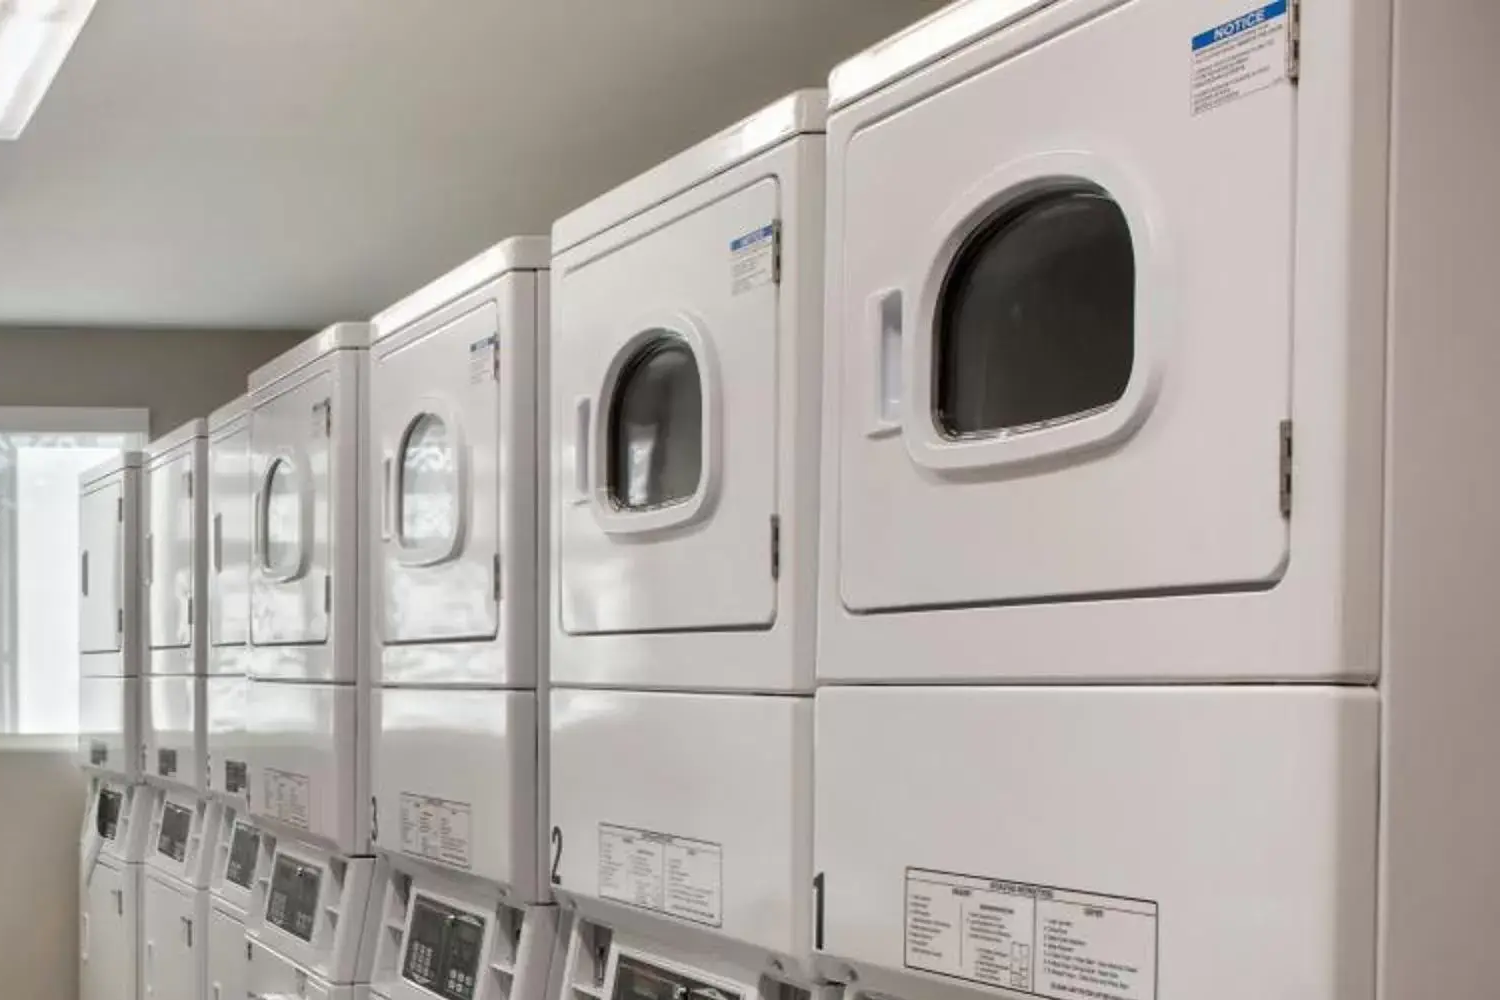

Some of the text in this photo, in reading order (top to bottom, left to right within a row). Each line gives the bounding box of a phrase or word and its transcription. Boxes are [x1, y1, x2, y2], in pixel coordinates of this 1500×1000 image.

[1213, 12, 1266, 41] NOTICE
[551, 826, 563, 885] 2
[812, 871, 825, 951] 1
